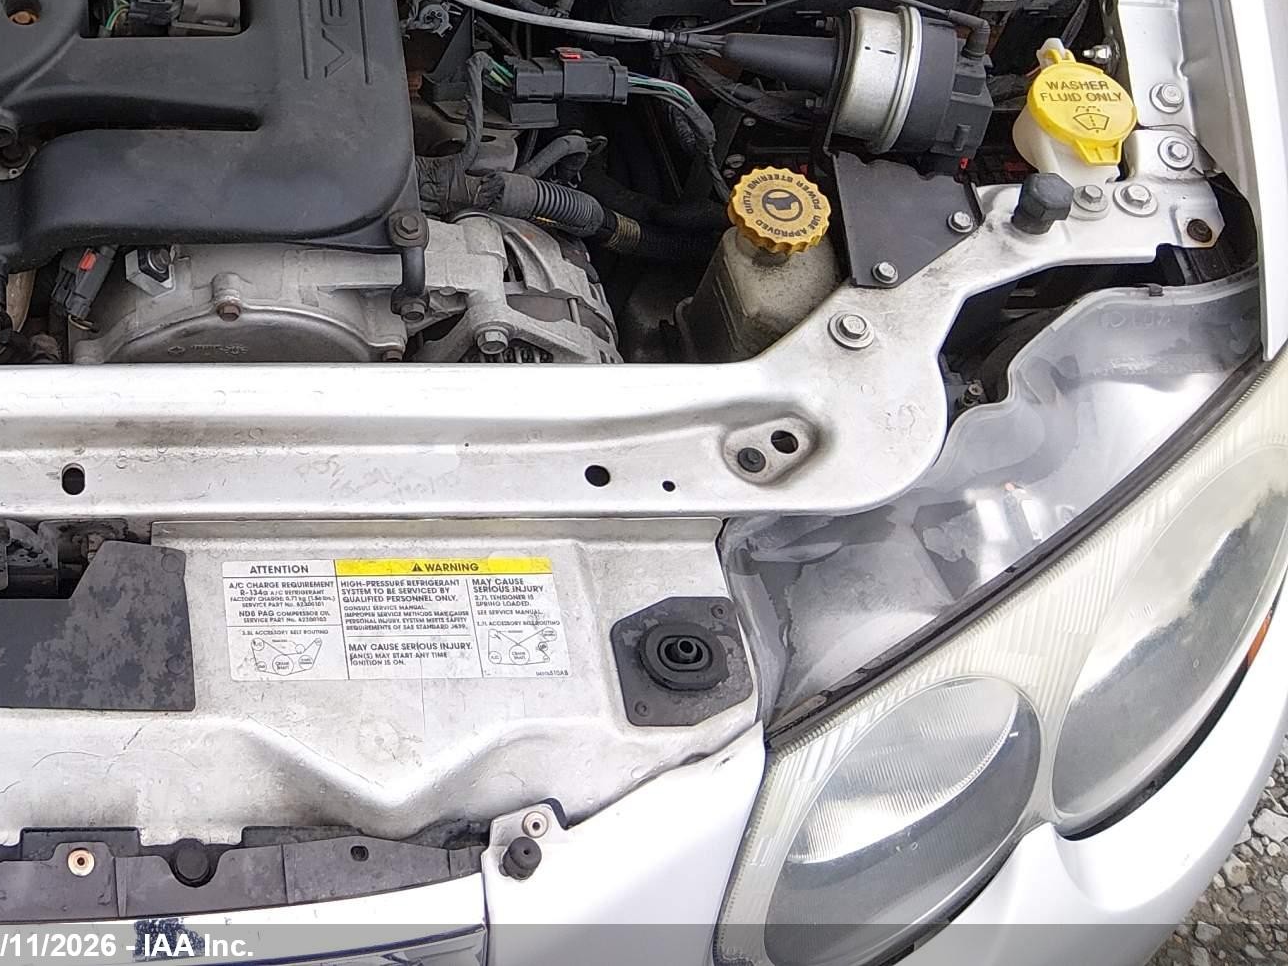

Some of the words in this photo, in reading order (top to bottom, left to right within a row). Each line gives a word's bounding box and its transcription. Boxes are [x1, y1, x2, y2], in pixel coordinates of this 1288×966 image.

[1046, 81, 1109, 90] WASHER
[1040, 93, 1081, 102] FLUID
[1086, 93, 1122, 102] ONLY
[748, 174, 793, 189] STEERING
[796, 181, 822, 210] POWER
[743, 190, 754, 214] FLUID
[808, 215, 821, 230] USE
[756, 219, 808, 237] APPROVED
[250, 565, 309, 574] ATTENTION
[424, 563, 479, 572] WARNING
[246, 581, 279, 589] CHARGE
[282, 580, 334, 588] REQUIREMENT
[341, 580, 405, 588] HIGH-PRESSURE
[407, 579, 460, 587] REFRIGERANT
[398, 587, 437, 595] SERVICED
[387, 595, 433, 603] PERSONNEL
[435, 594, 458, 602] ONLY.
[370, 643, 399, 651] CAUSE
[401, 642, 438, 650] SERIOUS
[440, 642, 473, 650] INJURY.
